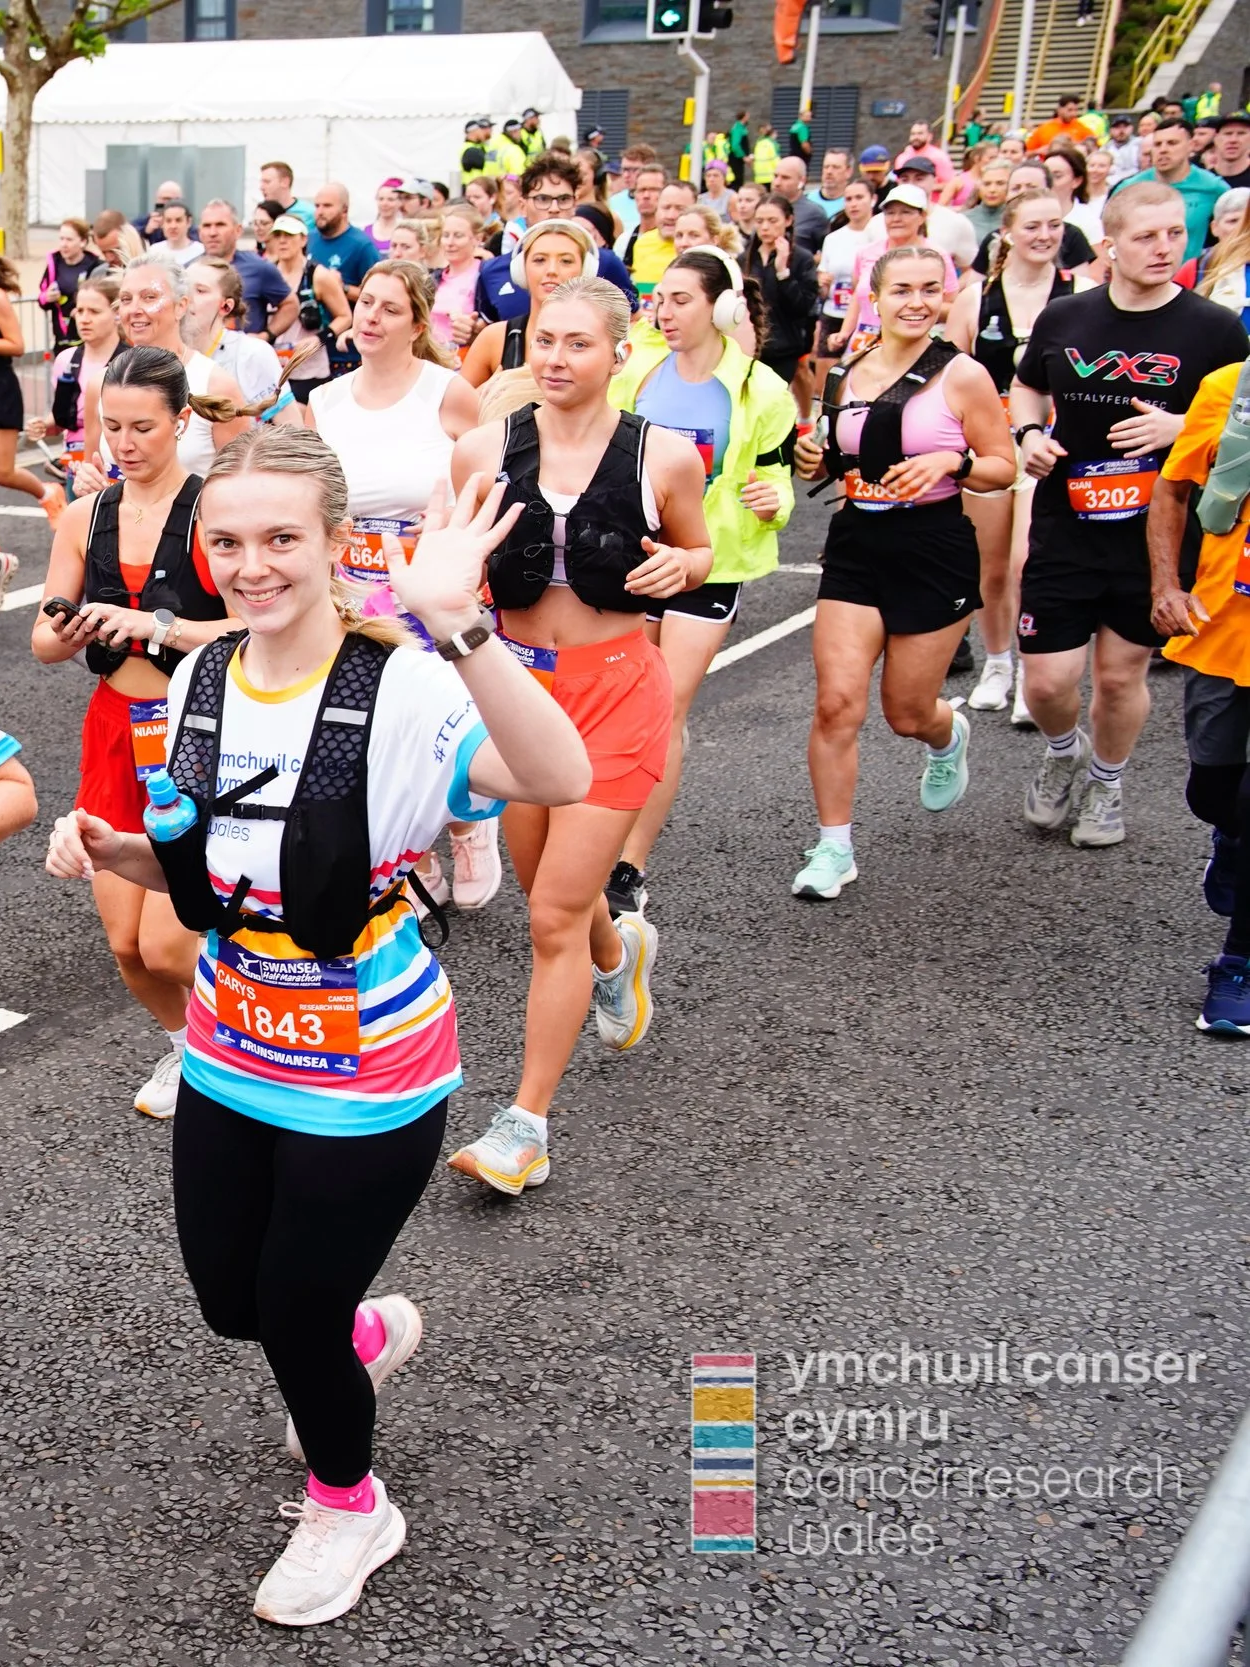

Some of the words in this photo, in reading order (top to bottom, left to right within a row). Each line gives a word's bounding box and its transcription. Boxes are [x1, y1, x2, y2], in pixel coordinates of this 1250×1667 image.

[1064, 347, 1181, 386] VX3
[1069, 481, 1092, 490] CIAN
[1085, 486, 1140, 508] 3202
[604, 651, 627, 664] TALA
[219, 751, 287, 773] mchwil
[262, 961, 321, 974] SWANSEA
[262, 972, 281, 980] Half
[280, 973, 322, 982] Marathon
[217, 969, 257, 1001] CARYS
[237, 1000, 325, 1046] 1843
[240, 1038, 329, 1069] #RUNSWANSEA
